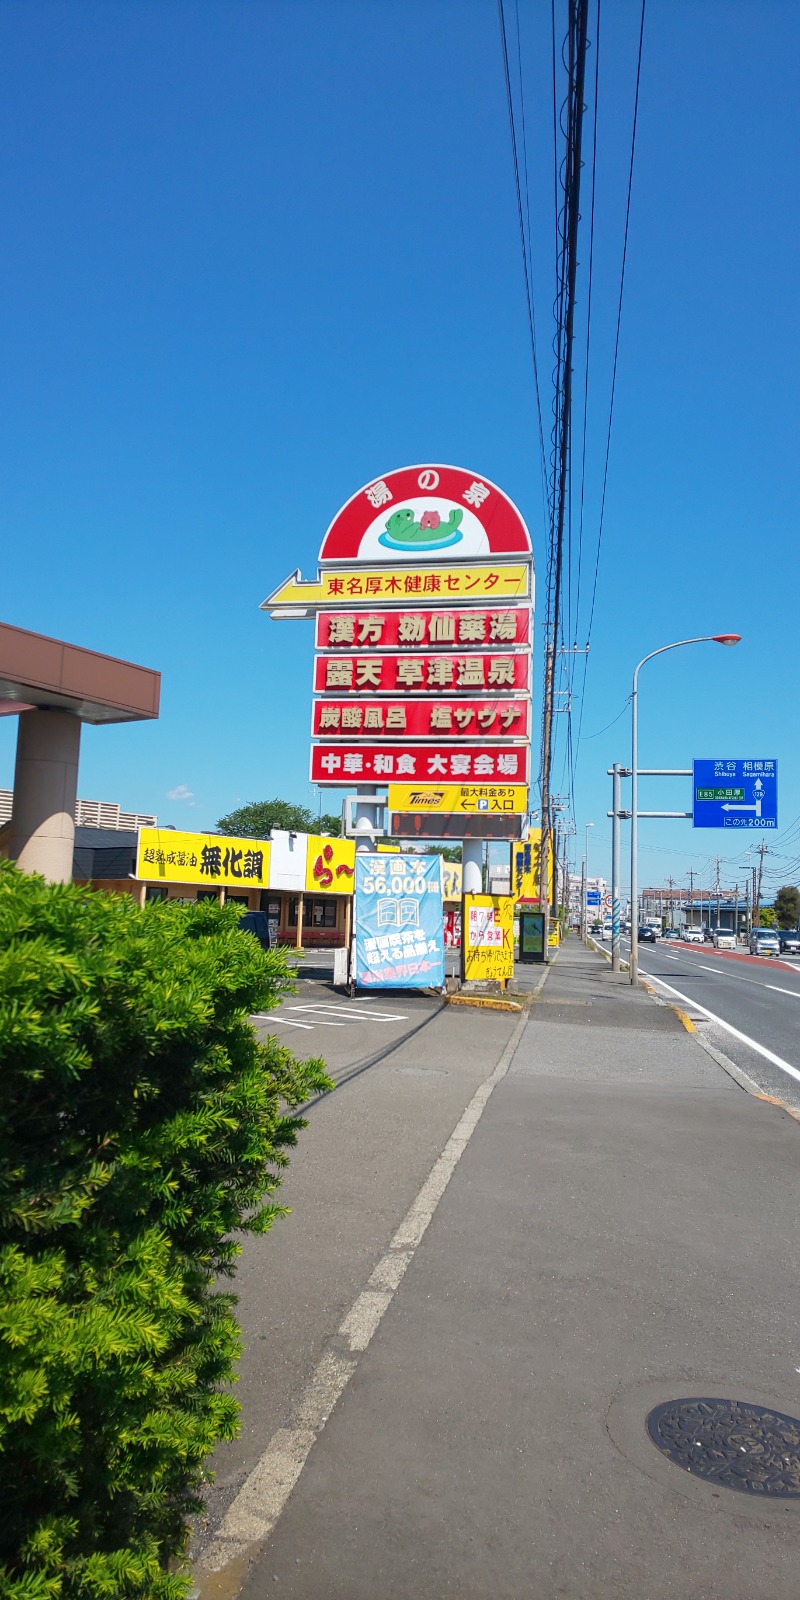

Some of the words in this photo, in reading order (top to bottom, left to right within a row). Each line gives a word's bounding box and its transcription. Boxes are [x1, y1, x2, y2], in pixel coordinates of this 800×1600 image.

[365, 469, 491, 509] 湯の泉
[327, 573, 521, 596] 東名厚木健康センター
[329, 616, 385, 643] 漢方
[397, 613, 518, 642] 効仙薬湯
[326, 659, 383, 687] 露天
[396, 658, 516, 686] 草津温泉
[319, 707, 407, 729] 炭酸風呂
[430, 706, 521, 729] 塩サウナ
[321, 752, 416, 775] 中華・和食
[427, 753, 518, 775] 大宴会場
[714, 761, 737, 771] 渋谷
[742, 761, 775, 771] 相模原
[409, 792, 441, 805] Times
[460, 788, 515, 797] 最大料金あり
[491, 799, 514, 810] 入口
[200, 844, 264, 880] 無化調
[369, 859, 427, 876] 漫画本
[366, 940, 440, 965] 超える品揃え
